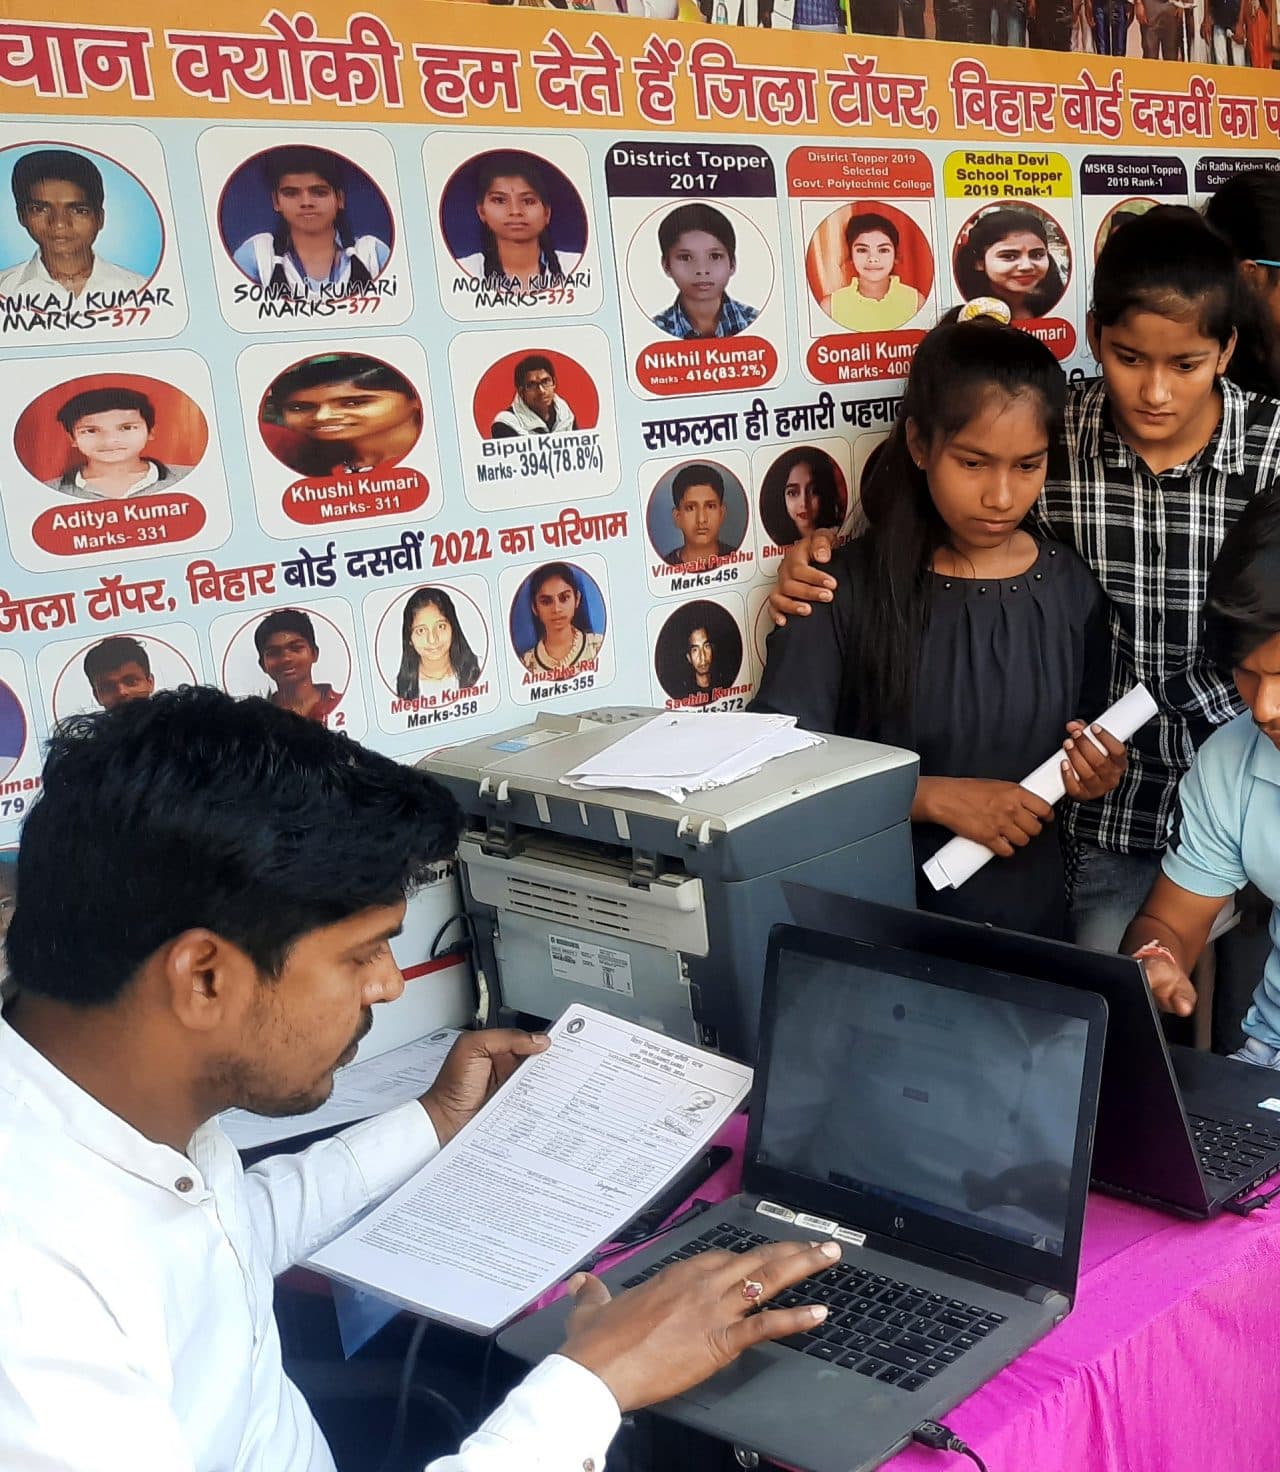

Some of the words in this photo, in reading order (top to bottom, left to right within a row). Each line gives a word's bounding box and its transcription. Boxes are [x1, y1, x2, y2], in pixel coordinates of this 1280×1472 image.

[166, 12, 402, 108] क्योंकी
[415, 46, 519, 116] हम
[533, 30, 622, 115] देते
[634, 33, 683, 124] हैं
[690, 40, 817, 124] जिला
[826, 55, 938, 132] टॉपर,
[950, 60, 1056, 136] बिहार
[1061, 69, 1124, 138] बोर्ड
[1131, 76, 1214, 138] दसवीं
[1219, 97, 1258, 138] का
[613, 149, 691, 167] District
[697, 151, 769, 171] Topper
[808, 152, 849, 164] District
[852, 153, 889, 165] Topper
[892, 154, 916, 164] 2019
[965, 153, 1013, 166] Radha
[1018, 154, 1049, 166] Devi
[1196, 161, 1208, 171] Sri
[1209, 161, 1233, 171] Radha
[842, 165, 889, 176] Selected
[957, 169, 1009, 181] School
[1013, 170, 1063, 183] Topper
[1084, 163, 1114, 174] MSKB
[1117, 164, 1148, 175] School
[1150, 165, 1182, 178] Topper
[670, 174, 718, 190] 2017
[792, 178, 824, 189] Govt.
[827, 179, 890, 190] Polytechnic
[893, 180, 932, 191] College
[964, 184, 999, 196] 2019
[1004, 185, 1053, 196] Rnak-1
[1107, 177, 1129, 187] 2019
[1131, 177, 1163, 187] Rank-1
[87, 288, 174, 309] KUMAR
[258, 296, 381, 320] MARKS-377
[475, 289, 574, 308] MARKS-373
[3, 308, 151, 332] MARKS-377
[1020, 323, 1067, 340] umari
[645, 351, 701, 369] Nikhil
[706, 349, 765, 366] Kumar
[817, 343, 870, 364] Sonali
[650, 375, 679, 385] Marks
[686, 364, 767, 382] 416(83.2%)
[839, 364, 883, 379] Marks-
[642, 412, 738, 451] सफलता
[744, 398, 769, 441] ही
[775, 391, 835, 437] हमारी
[483, 437, 532, 458] Bipul
[538, 432, 600, 451] Kumar
[477, 463, 517, 482] Marks-
[291, 481, 352, 503] Khushi
[358, 474, 419, 495] Kumari
[52, 510, 118, 530] Aditya
[124, 502, 189, 522] Kumar
[321, 500, 371, 518] Marks-
[375, 496, 400, 511] 311
[73, 531, 132, 549] Marks-
[137, 524, 167, 541] 331
[763, 544, 795, 558] Bhu
[84, 574, 176, 621] टॉपर,
[187, 559, 275, 604] बिहार
[281, 542, 336, 588] बोर्ड
[344, 530, 424, 578] दसवीं
[430, 527, 492, 568] 2022
[499, 525, 534, 554] का
[541, 508, 628, 547] परिणाम
[652, 557, 706, 578] Vinayak
[671, 567, 739, 591] Marks-456
[391, 694, 436, 715] Megha
[442, 681, 488, 705] Kumari
[530, 675, 594, 701] Marks-355
[712, 683, 753, 700] Kumar
[407, 701, 477, 729] Marks-358
[1, 797, 25, 817] 79
